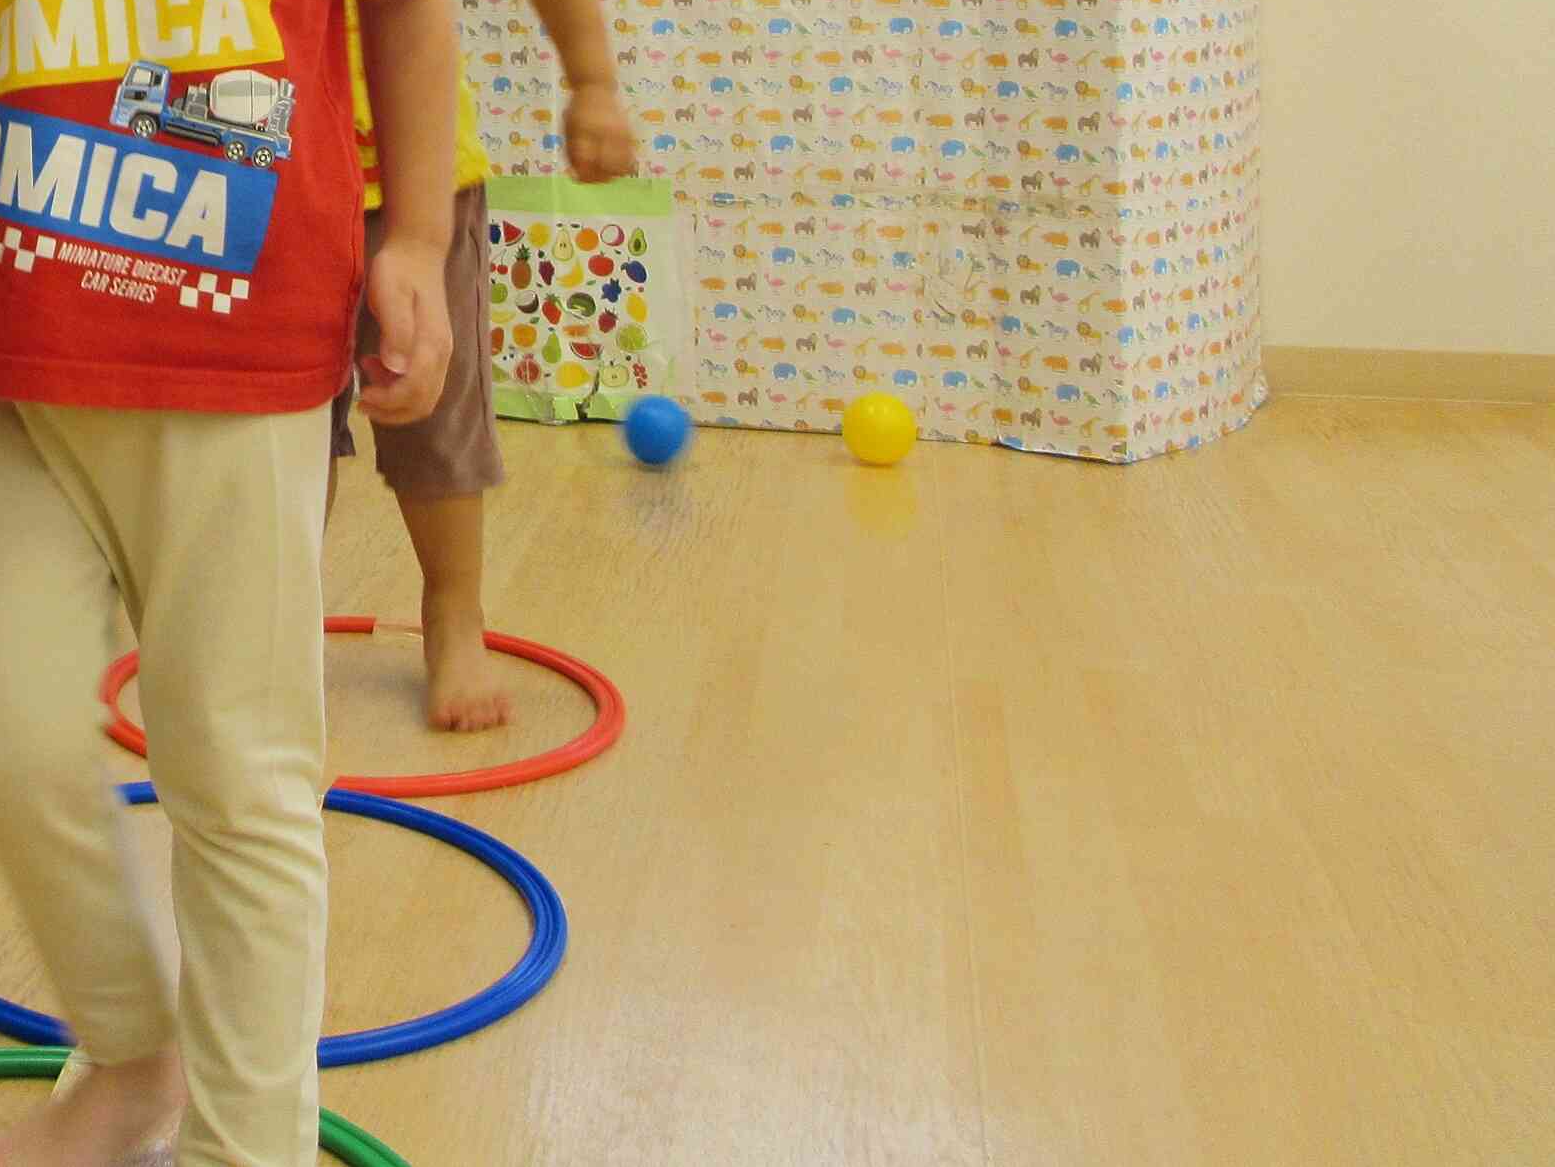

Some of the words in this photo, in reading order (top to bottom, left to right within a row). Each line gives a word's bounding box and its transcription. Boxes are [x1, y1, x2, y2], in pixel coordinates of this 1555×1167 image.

[58, 242, 131, 274] MINIATURE
[132, 260, 187, 286] DIECAST
[81, 271, 110, 293] CAR
[110, 278, 157, 303] SERIES
